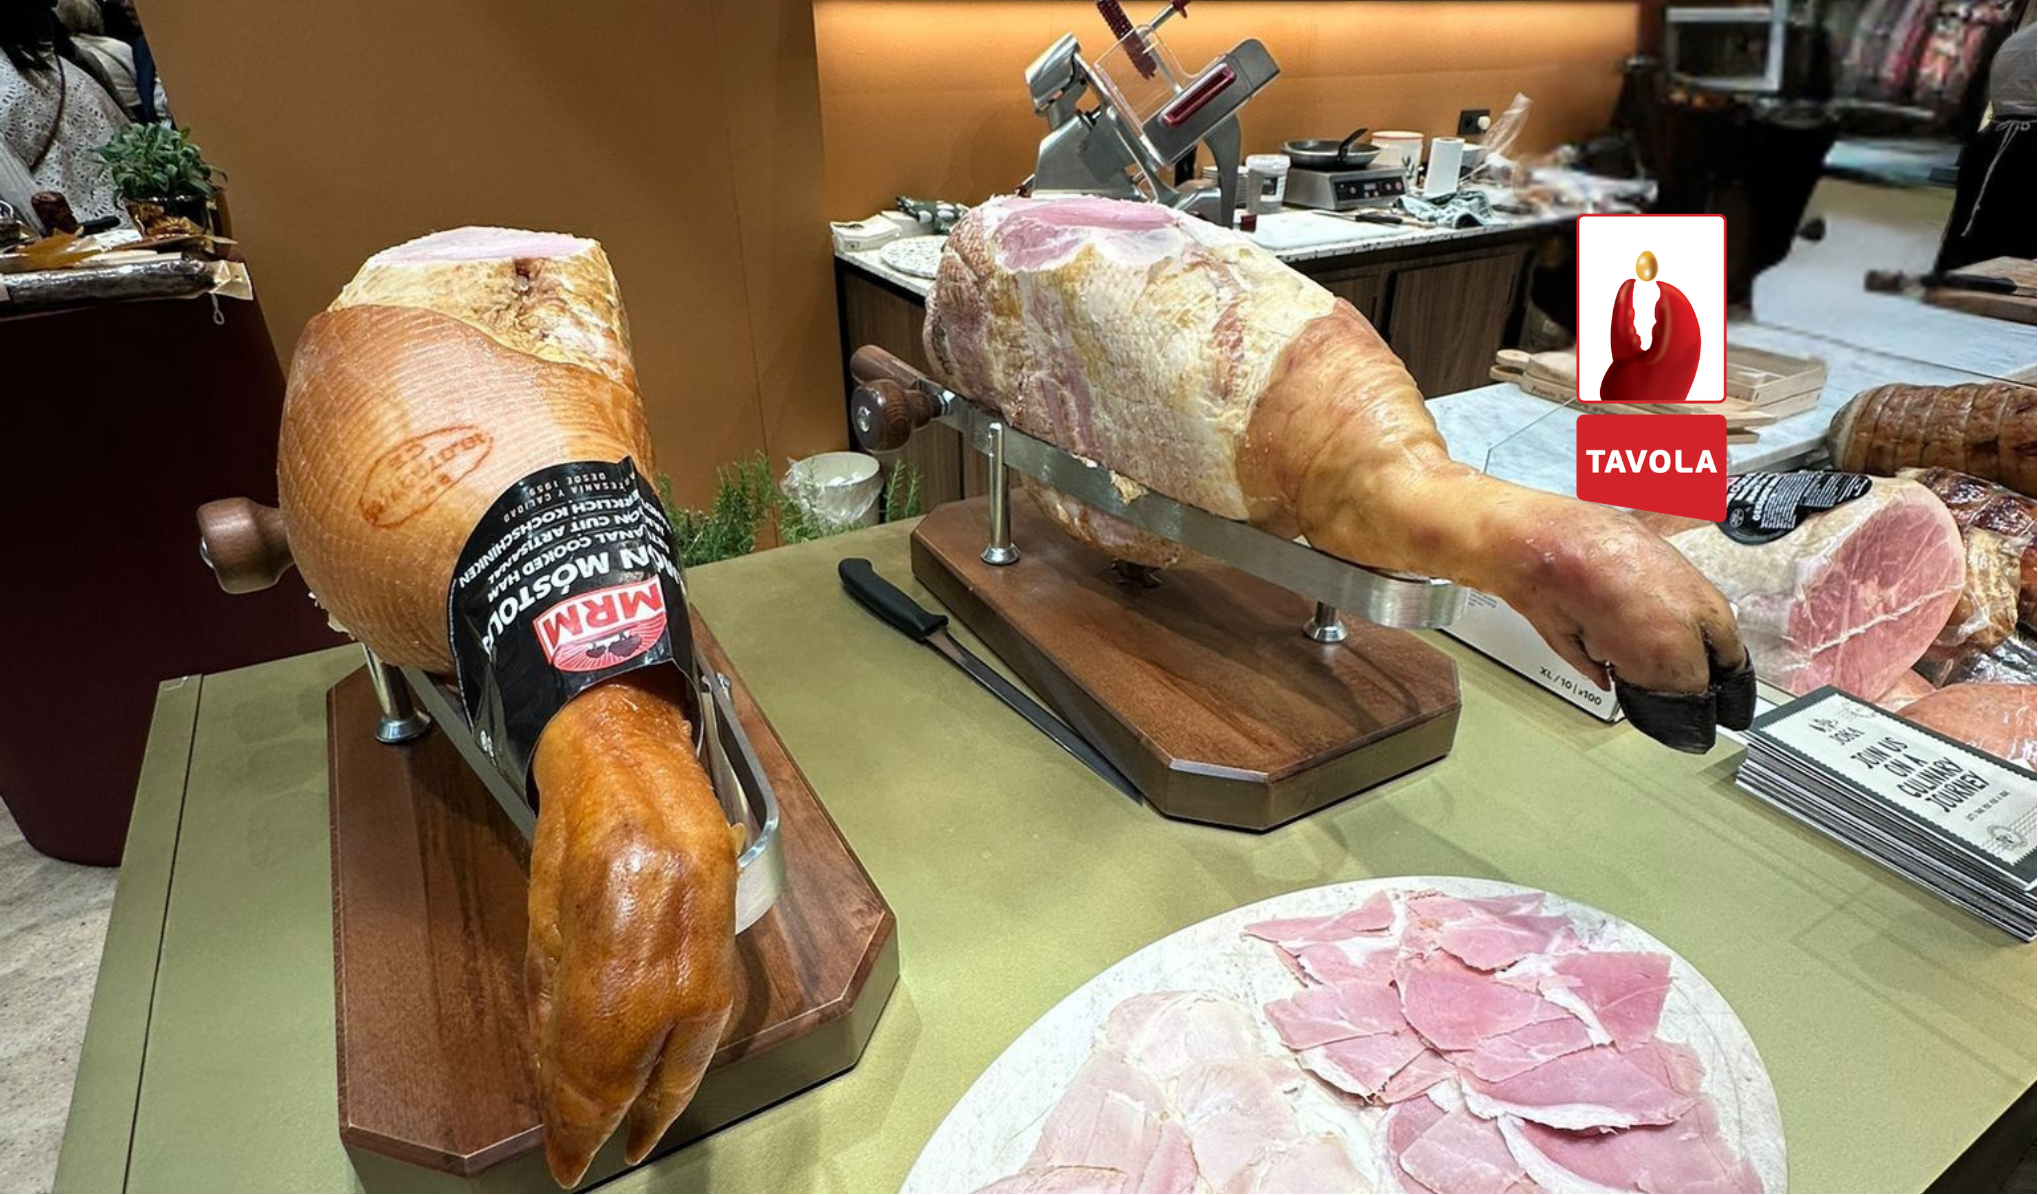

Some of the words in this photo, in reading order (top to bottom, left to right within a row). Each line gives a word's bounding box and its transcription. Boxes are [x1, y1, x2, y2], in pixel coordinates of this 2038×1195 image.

[529, 480, 559, 496] 1959
[558, 489, 565, 498] Y
[566, 472, 606, 485] DESDE
[503, 493, 552, 523] CALIDAD
[570, 516, 611, 533] CUIT
[458, 506, 569, 589] KOCHSCHINKEN
[487, 525, 565, 584] ARTISANAL
[522, 536, 592, 575] COOKED
[487, 570, 520, 602] HAM
[543, 583, 664, 647] MRM
[1540, 666, 1553, 680] XL
[1561, 677, 1572, 689] 10
[1850, 745, 1891, 769] JOIN
[1878, 737, 1908, 752] US
[1884, 758, 1916, 778] ON
[1903, 753, 1928, 768] A
[1897, 757, 1963, 798] CULINARY
[1925, 770, 1989, 813] JOURNEY
